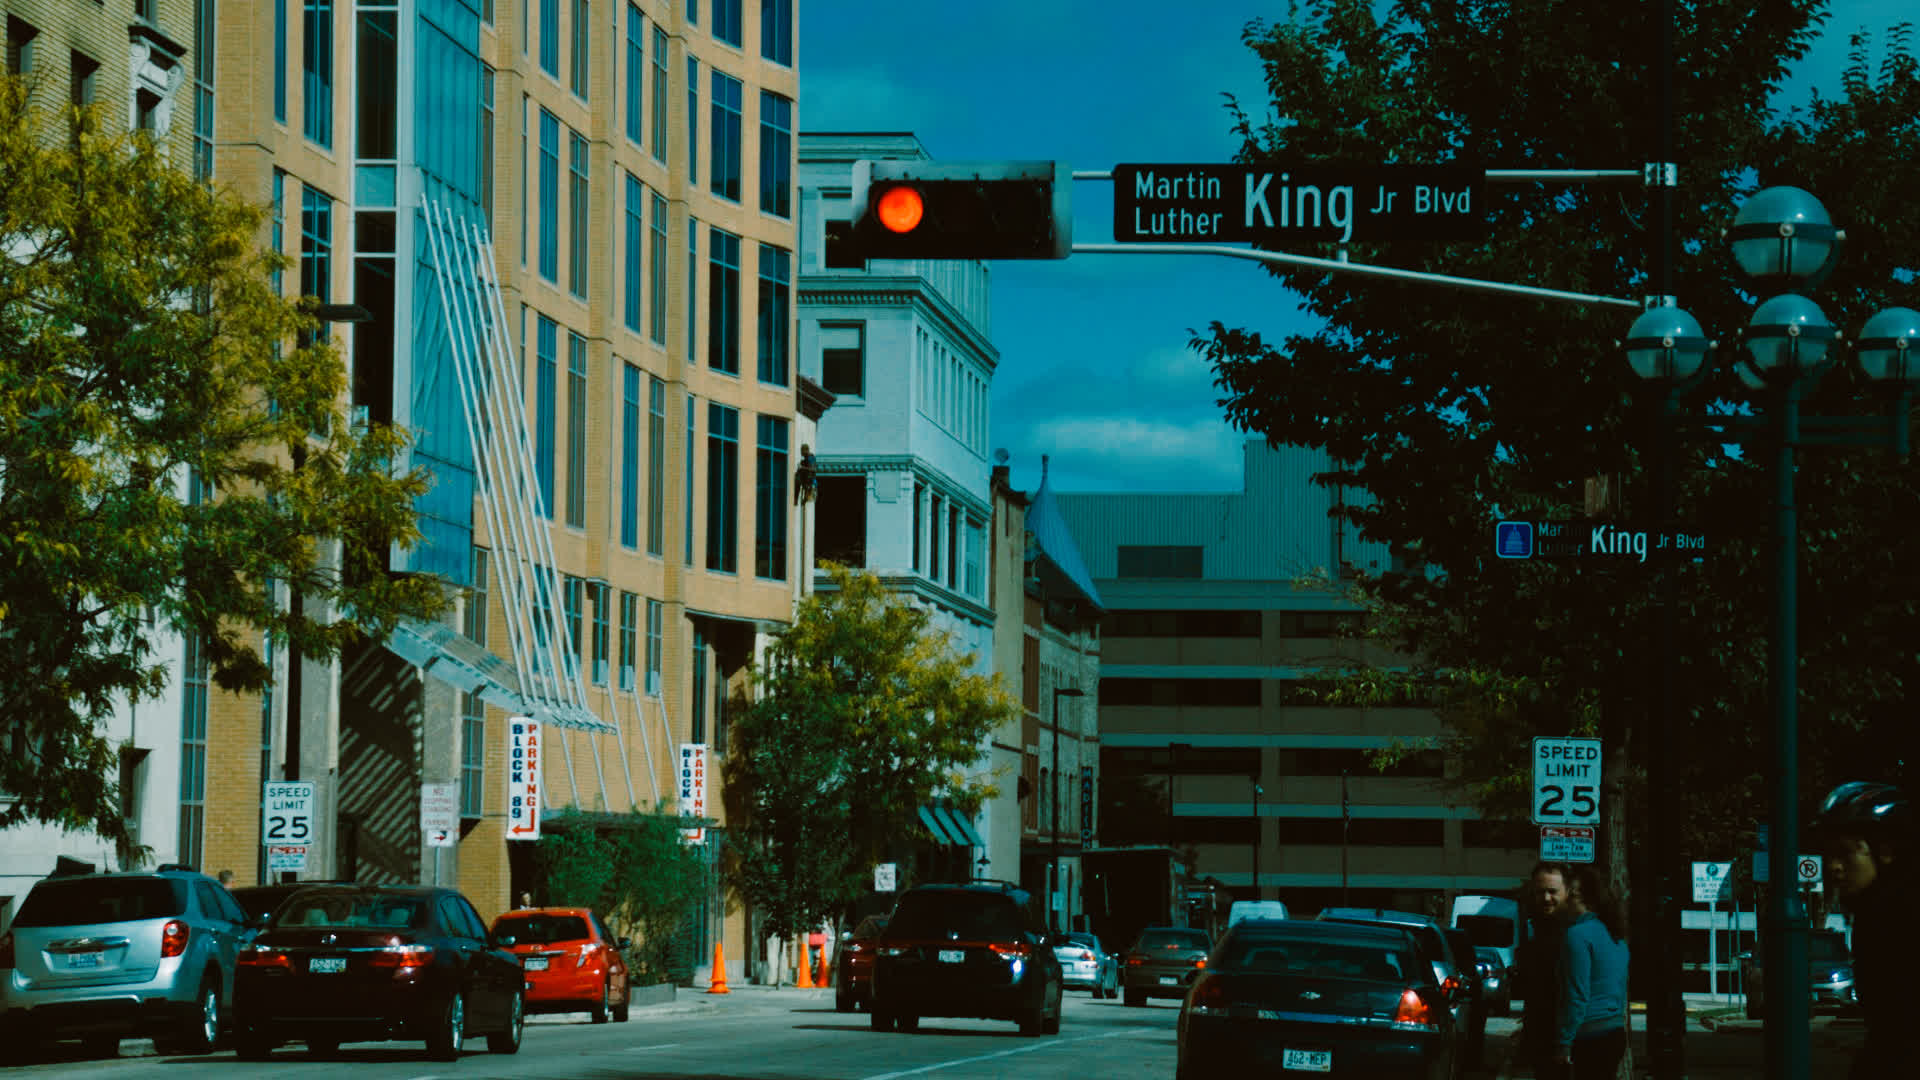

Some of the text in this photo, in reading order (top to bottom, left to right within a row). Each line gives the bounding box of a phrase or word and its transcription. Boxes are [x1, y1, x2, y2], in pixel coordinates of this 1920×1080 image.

[1136, 171, 1221, 199] Martin
[1136, 207, 1223, 235] Luther
[1245, 173, 1472, 244] King Jr Blvd
[1592, 525, 1647, 563] King
[1656, 532, 1671, 550] Jr
[1676, 533, 1705, 550] Blvd
[526, 723, 537, 807] PARKING
[1540, 745, 1597, 760] SPEED
[511, 724, 523, 819] BLOCK 89
[682, 748, 691, 798] BLOCK
[1545, 763, 1591, 777] LIMIT
[269, 787, 311, 798] SPEED
[272, 800, 305, 810] LIMIT
[1539, 785, 1596, 817] 25
[268, 816, 309, 838] 25
